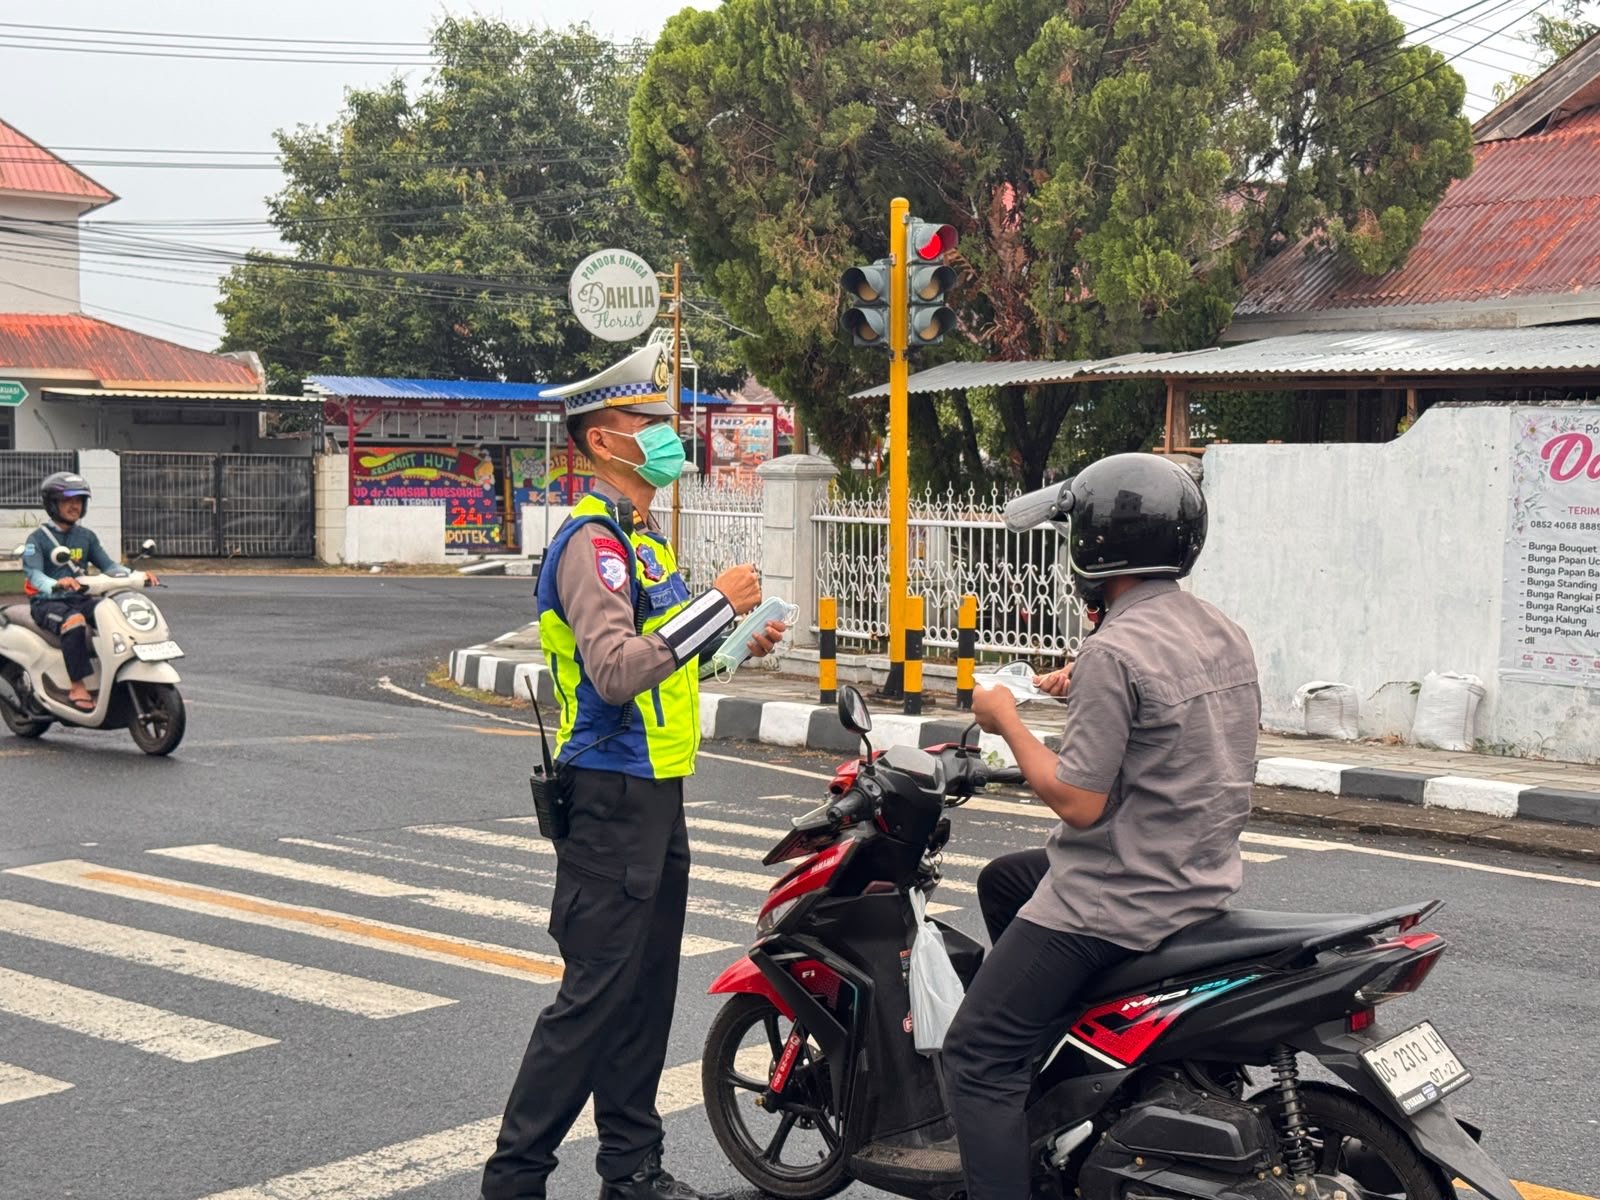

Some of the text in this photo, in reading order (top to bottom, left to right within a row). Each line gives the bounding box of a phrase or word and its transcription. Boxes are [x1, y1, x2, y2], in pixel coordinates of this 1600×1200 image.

[581, 254, 648, 280] PONDOK BUNGA
[577, 281, 656, 314] DAHLIA
[592, 310, 644, 329] Florist
[371, 453, 457, 477] SELAMAT HUT
[374, 498, 398, 506] KOTA
[1530, 520, 1552, 529] 0852
[1554, 521, 1577, 530] 4068
[1528, 541, 1598, 555] Bunga Bouquet
[1527, 553, 1556, 565] Bunga
[1558, 555, 1586, 566] Papan
[1527, 565, 1556, 577] Bunga
[1557, 567, 1586, 578] Papan
[1527, 577, 1598, 592] Bunga Standing
[1526, 589, 1555, 601] Bunga
[1556, 591, 1593, 603] Rangkai
[1526, 601, 1554, 613] Bunga
[1525, 612, 1588, 628] Bunga Kalung
[1525, 624, 1553, 636] bunga
[1554, 626, 1583, 638] Papan
[1524, 636, 1535, 645] dll
[1393, 1041, 1428, 1073] 2313
[1422, 1030, 1447, 1056] LH
